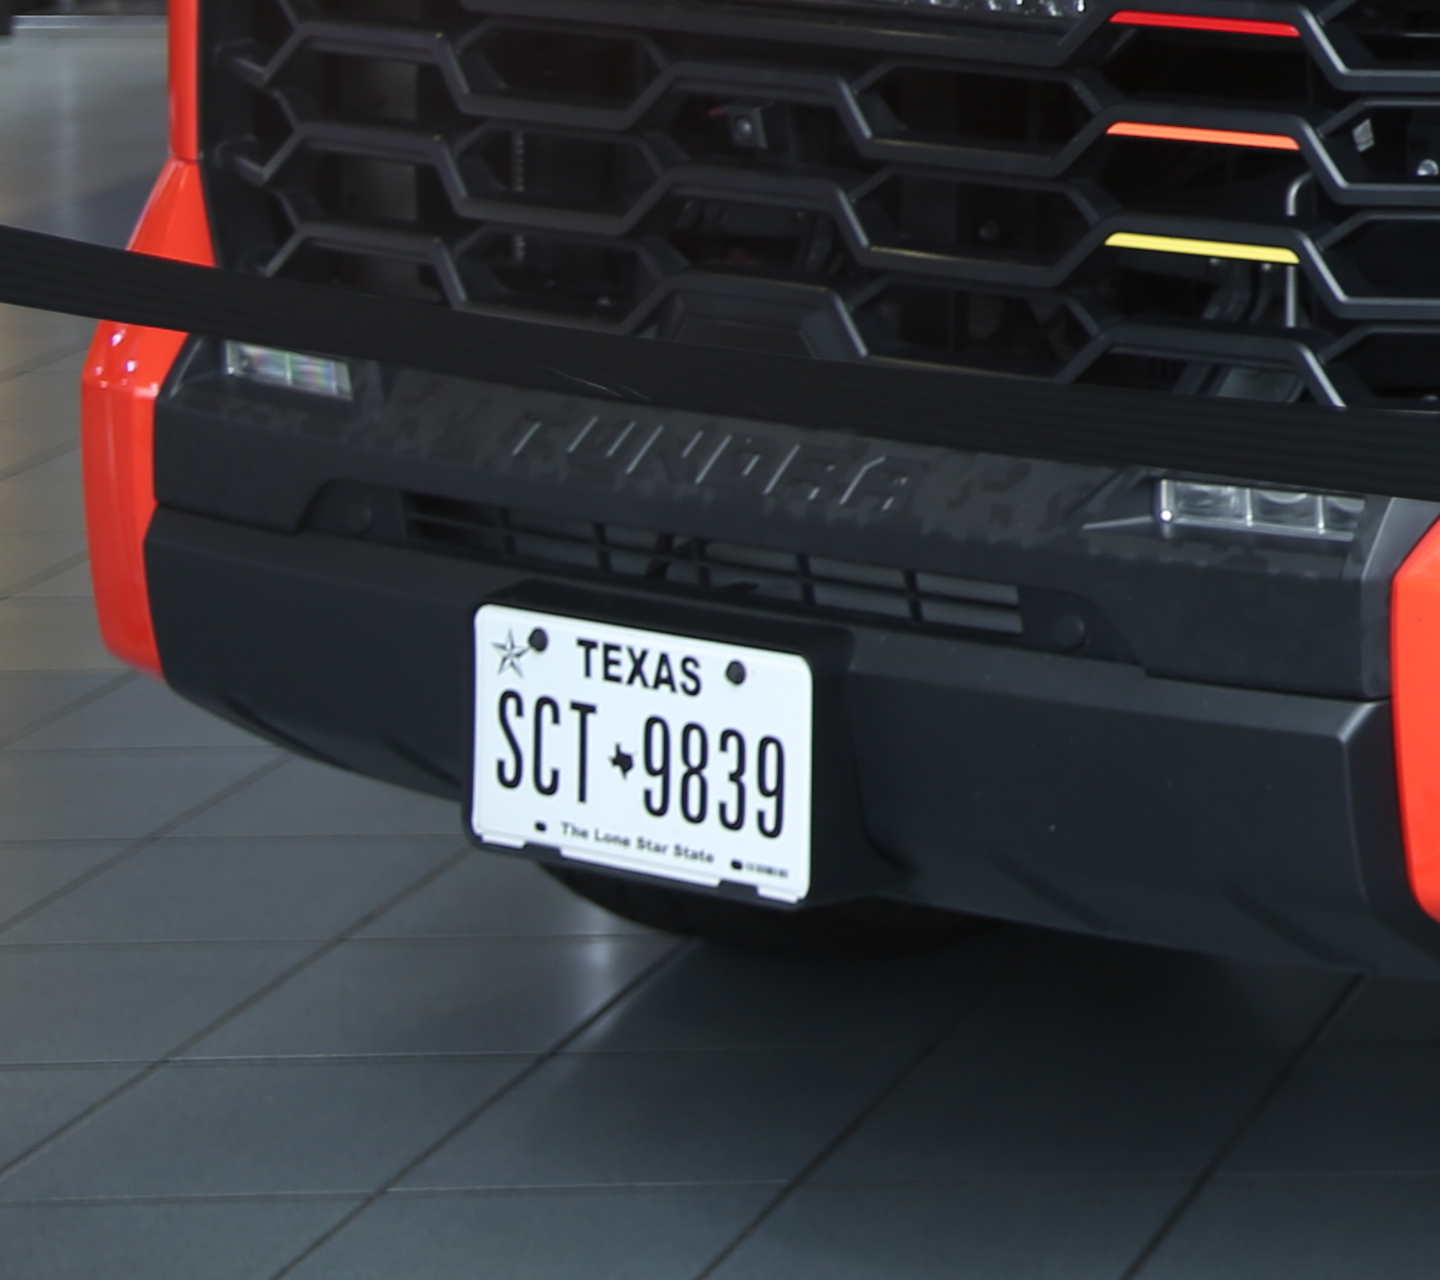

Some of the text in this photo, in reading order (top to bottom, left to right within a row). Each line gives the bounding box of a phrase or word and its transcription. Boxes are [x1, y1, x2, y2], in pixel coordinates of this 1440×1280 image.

[576, 637, 702, 697] TEXAS
[496, 689, 786, 839] SCT 9839
[560, 821, 715, 864] The Lone Star State
